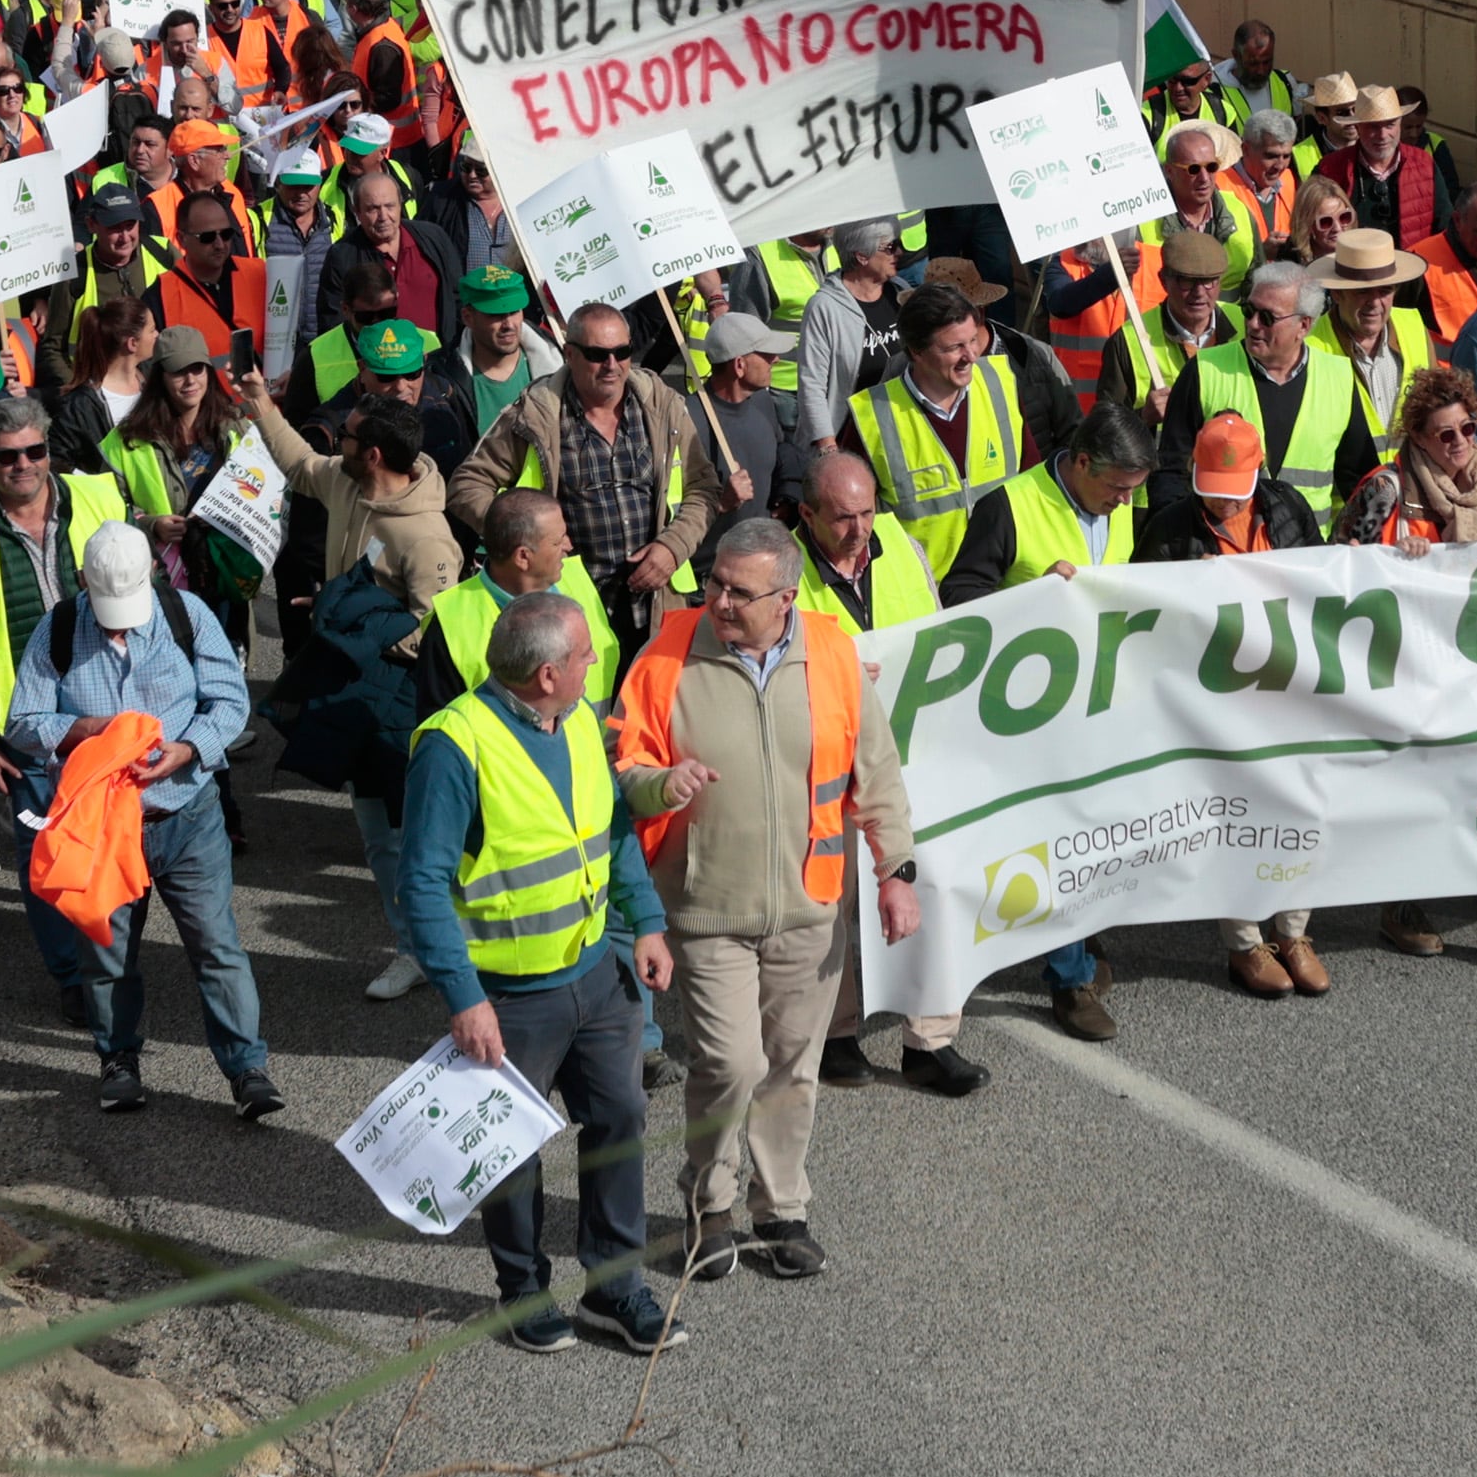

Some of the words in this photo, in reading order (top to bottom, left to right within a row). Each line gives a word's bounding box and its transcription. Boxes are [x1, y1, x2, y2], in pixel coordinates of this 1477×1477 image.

[123, 19, 136, 29] Por
[139, 23, 149, 31] un
[512, 35, 745, 144] EUROPA
[741, 6, 835, 86] NO
[700, 125, 794, 206] EL
[798, 82, 997, 175] FUTUR
[989, 115, 1045, 144] COAG
[1035, 158, 1070, 181] UPA
[534, 196, 589, 232] COAG
[1102, 194, 1143, 218] Campo
[1142, 187, 1168, 205] Vivo
[583, 232, 612, 254] UPA
[1035, 223, 1058, 241] Por
[1061, 216, 1079, 231] un
[652, 251, 702, 279] Campo
[704, 242, 736, 260] Vivo
[0, 269, 40, 293] Campo
[42, 261, 70, 277] Vivo
[608, 283, 627, 302] un
[225, 460, 264, 489] COAG
[231, 512, 244, 523] LOS
[242, 503, 253, 515] UN
[252, 510, 271, 530] CAMPO
[889, 609, 1162, 767] Por
[1197, 587, 1402, 695] un
[1054, 794, 1249, 861] cooperativas
[1056, 821, 1321, 896] agro-alimentarias
[1255, 860, 1312, 884] Cádiz
[426, 1063, 445, 1081] un
[380, 1081, 426, 1125] Campo
[355, 1128, 384, 1153] Vivo
[458, 1128, 489, 1155] UPA
[462, 1146, 517, 1201] COAG
[408, 1176, 434, 1206] ASAJA
